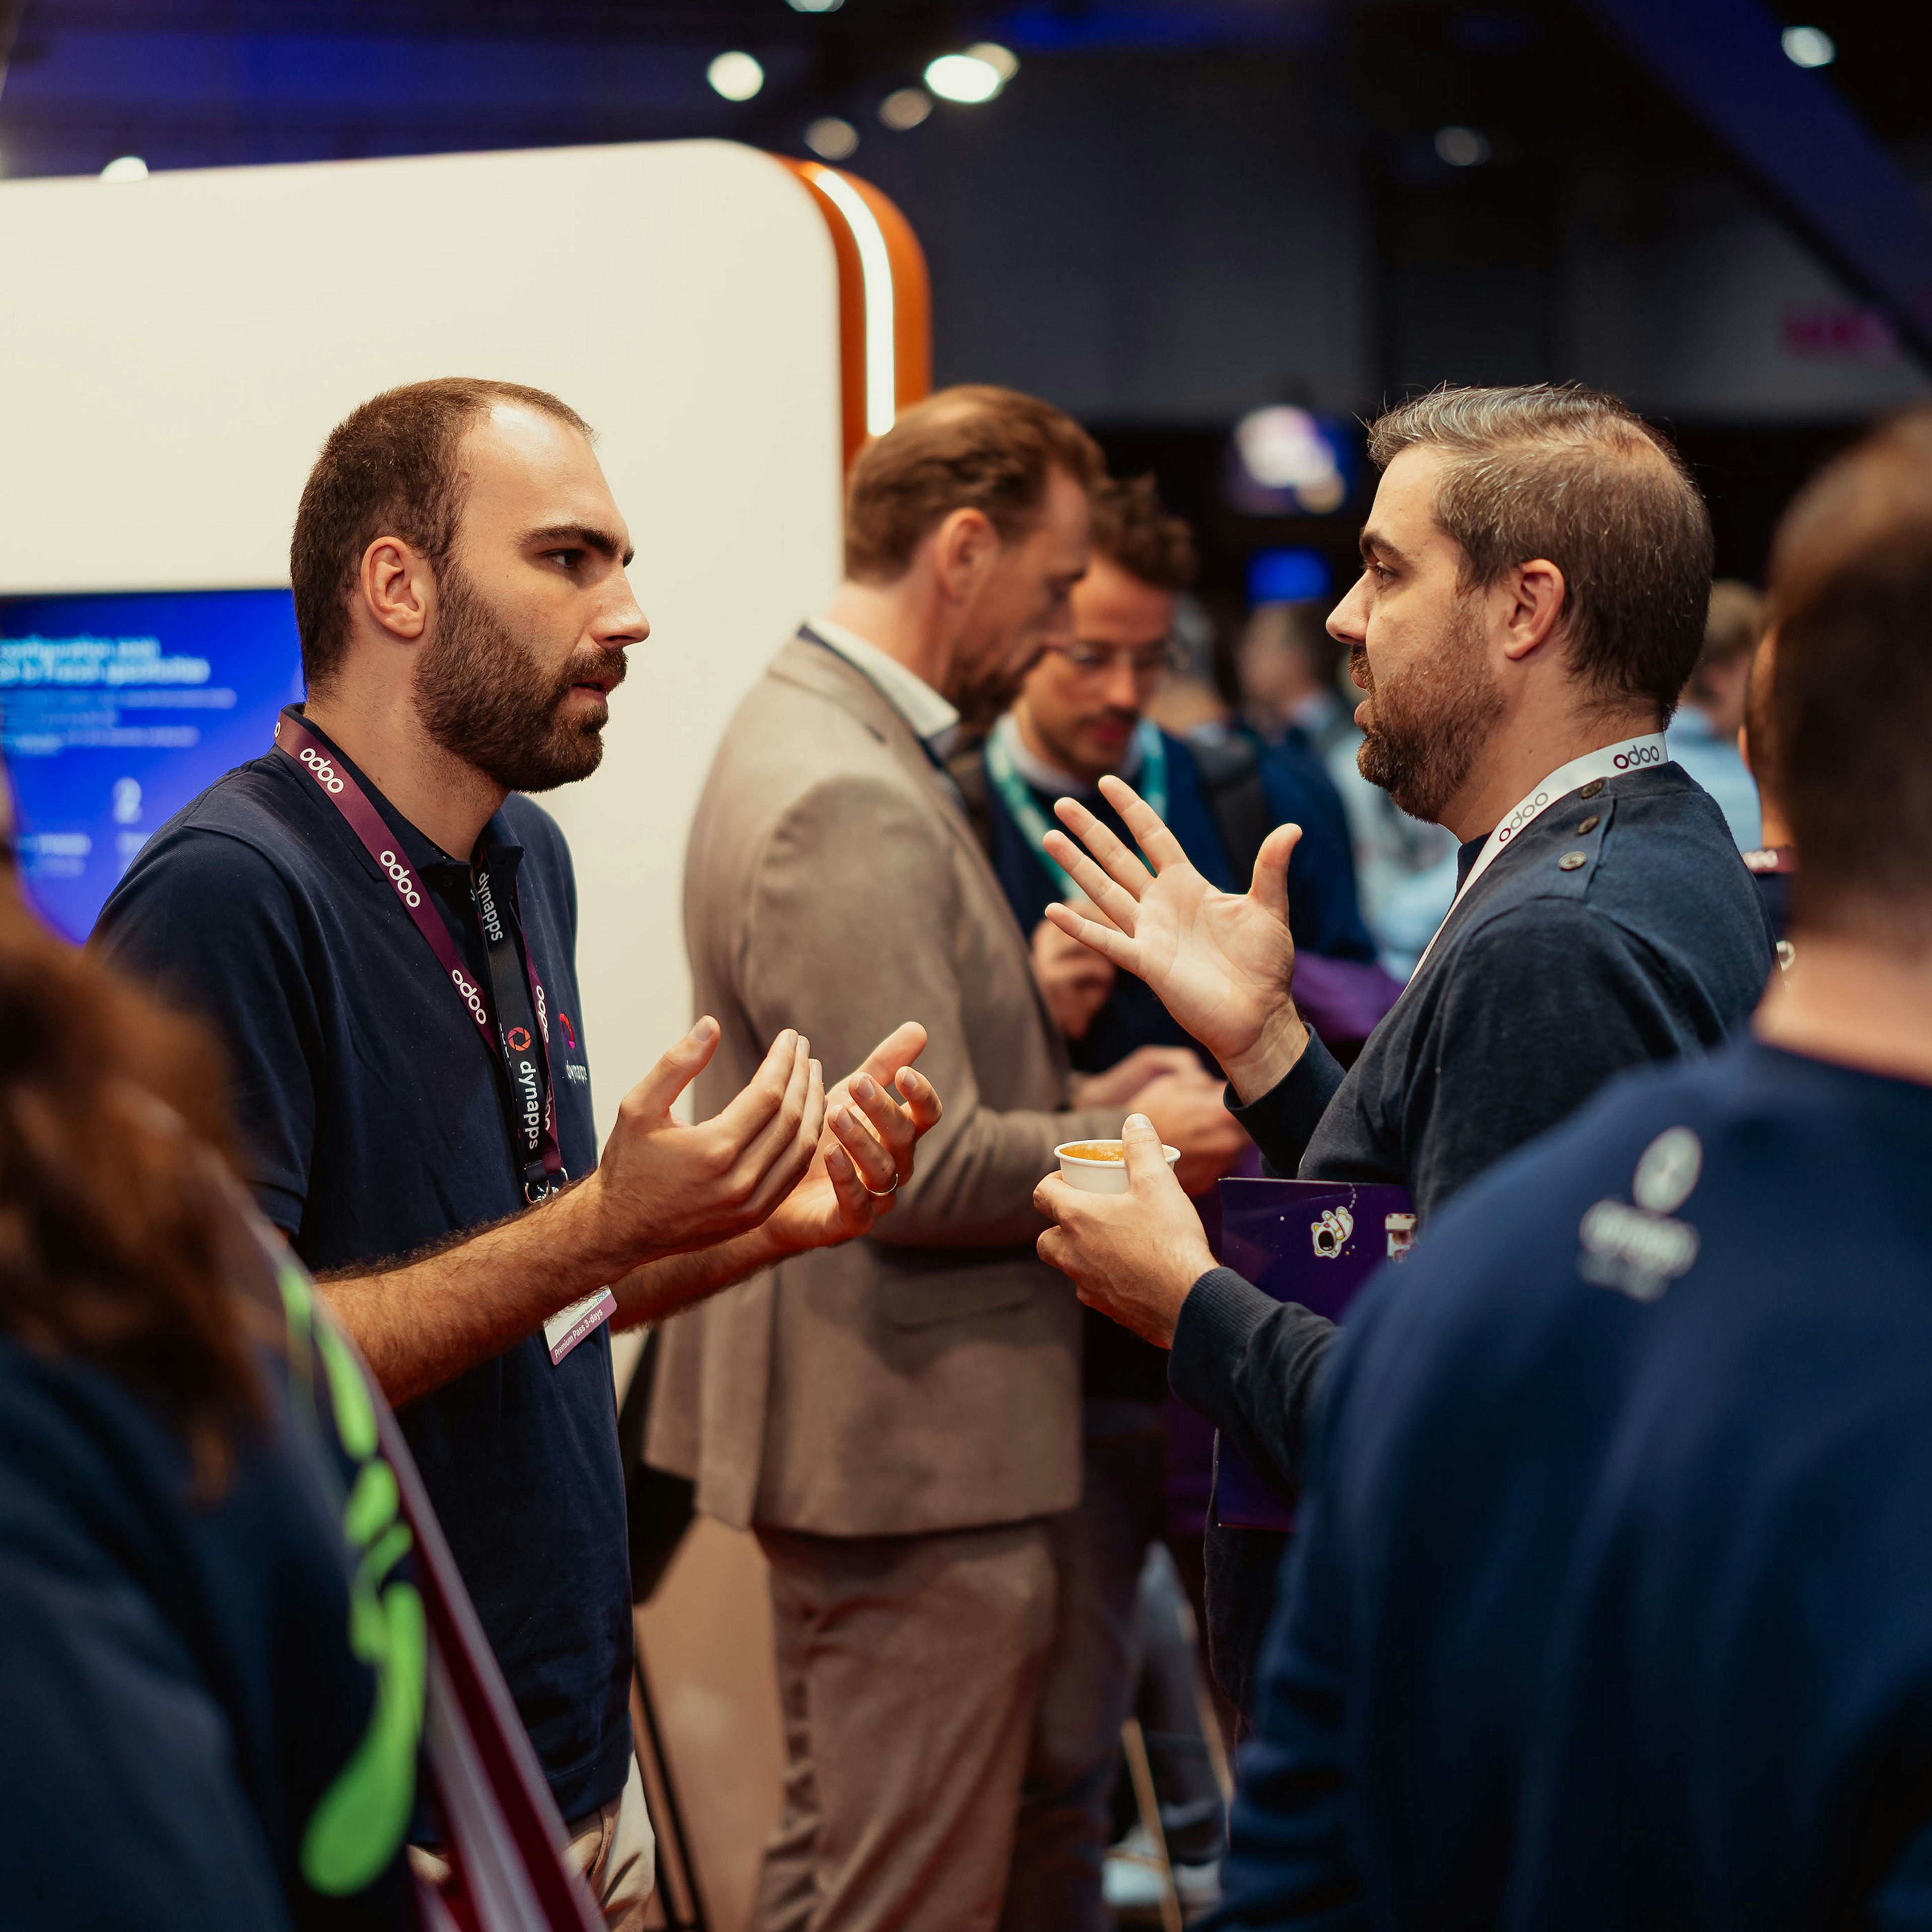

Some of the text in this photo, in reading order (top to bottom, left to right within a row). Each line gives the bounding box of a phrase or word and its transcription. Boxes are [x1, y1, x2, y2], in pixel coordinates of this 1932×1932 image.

[300, 748, 344, 793] odoo
[1614, 745, 1659, 769] odoo
[1499, 792, 1548, 842] odoo
[380, 850, 421, 907] odoo
[477, 872, 503, 941] dynapps
[452, 970, 486, 1024] odoo
[536, 985, 549, 1043] odoo
[519, 1061, 539, 1150] dynapps
[554, 1335, 574, 1358] Premium
[573, 1324, 586, 1339] Pass
[584, 1309, 603, 1328] 3-days
